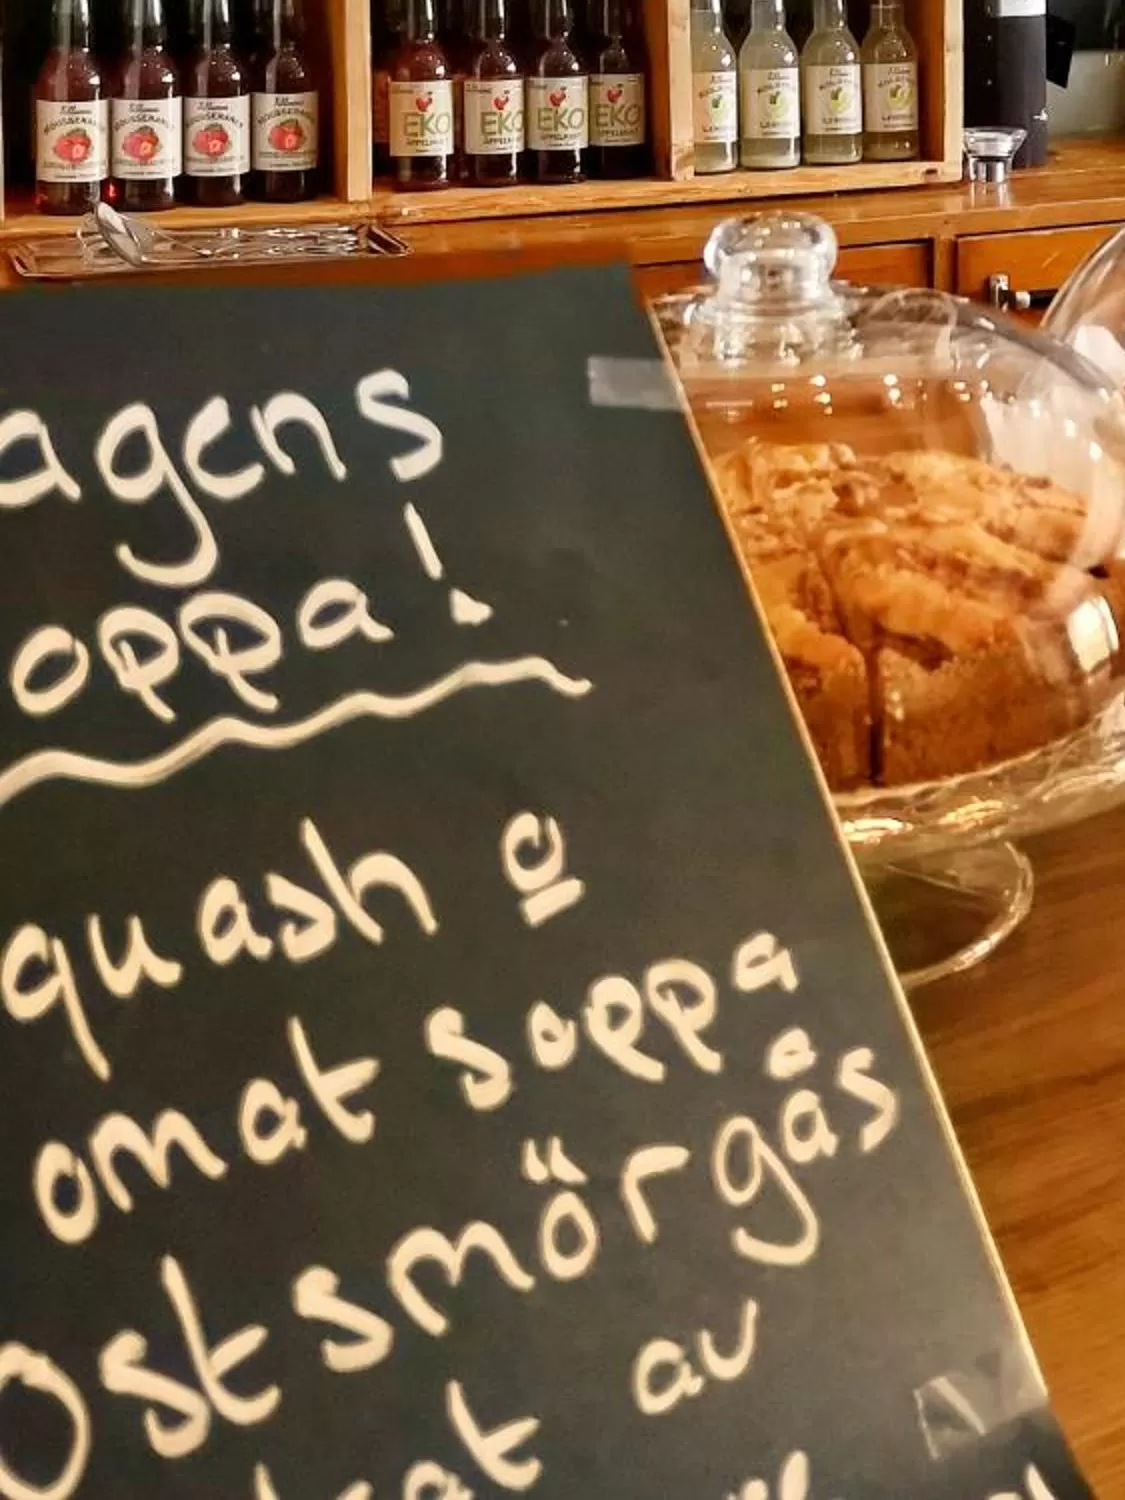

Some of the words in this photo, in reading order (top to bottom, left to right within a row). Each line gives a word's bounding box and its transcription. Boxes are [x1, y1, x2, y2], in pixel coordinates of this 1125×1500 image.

[404, 111, 451, 137] EKO
[481, 110, 524, 135] EKO
[537, 107, 585, 131] EKO
[595, 103, 641, 127] EKO
[424, 930, 798, 1112] soppa
